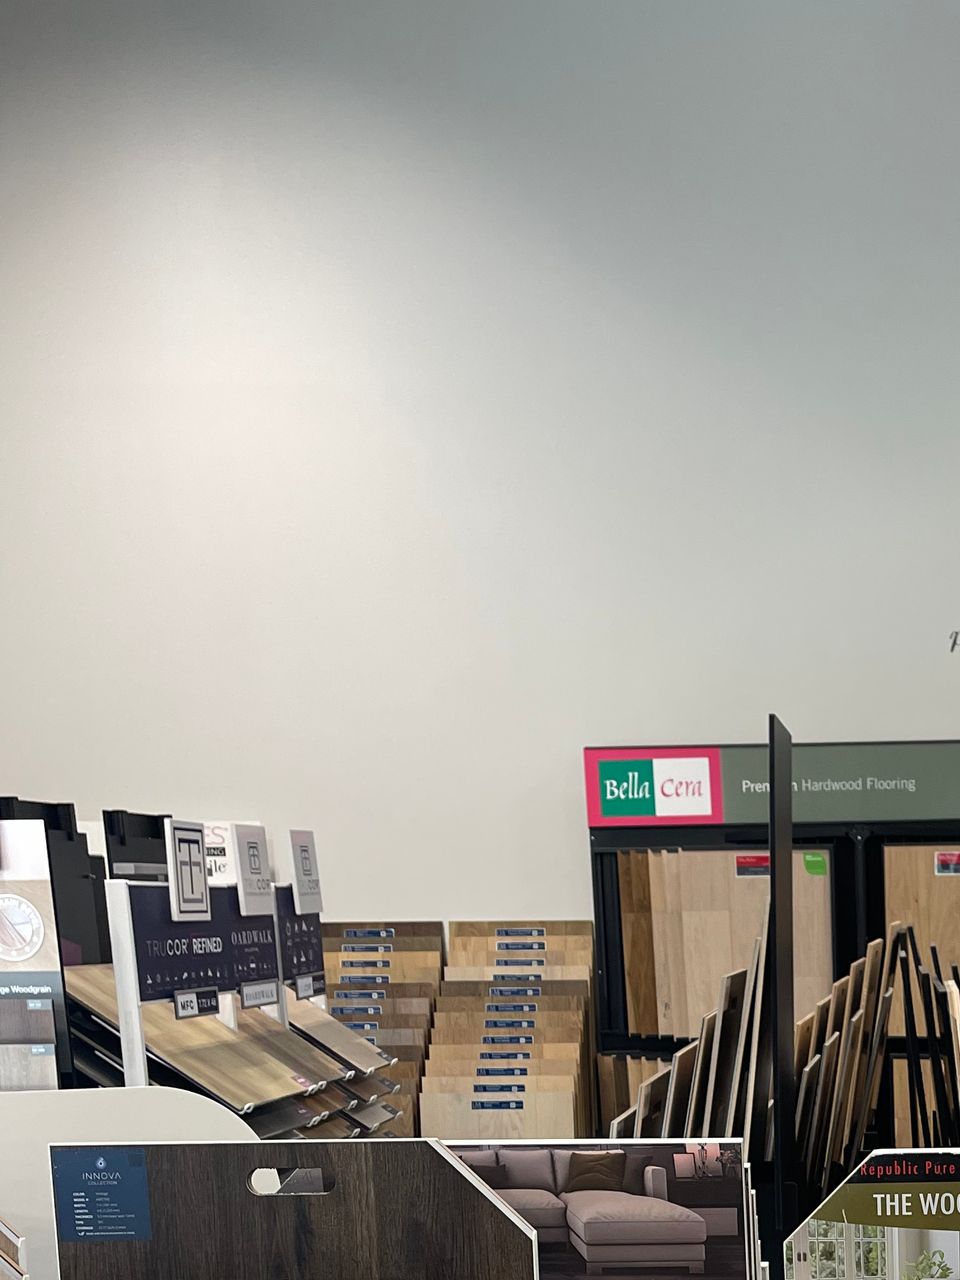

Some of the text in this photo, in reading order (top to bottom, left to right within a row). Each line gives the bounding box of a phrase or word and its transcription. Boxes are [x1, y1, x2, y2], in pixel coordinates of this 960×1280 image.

[604, 772, 703, 799] Bella Cera
[802, 779, 862, 791] Hardwood
[867, 777, 916, 792] Flooring
[231, 930, 272, 945] OARDWALK
[192, 938, 222, 954] REFINED
[11, 986, 51, 994] Woodgrain
[180, 1000, 194, 1010] MFC
[861, 1161, 918, 1178] Republic
[925, 1161, 955, 1174] Pure
[873, 1194, 912, 1216] THE
